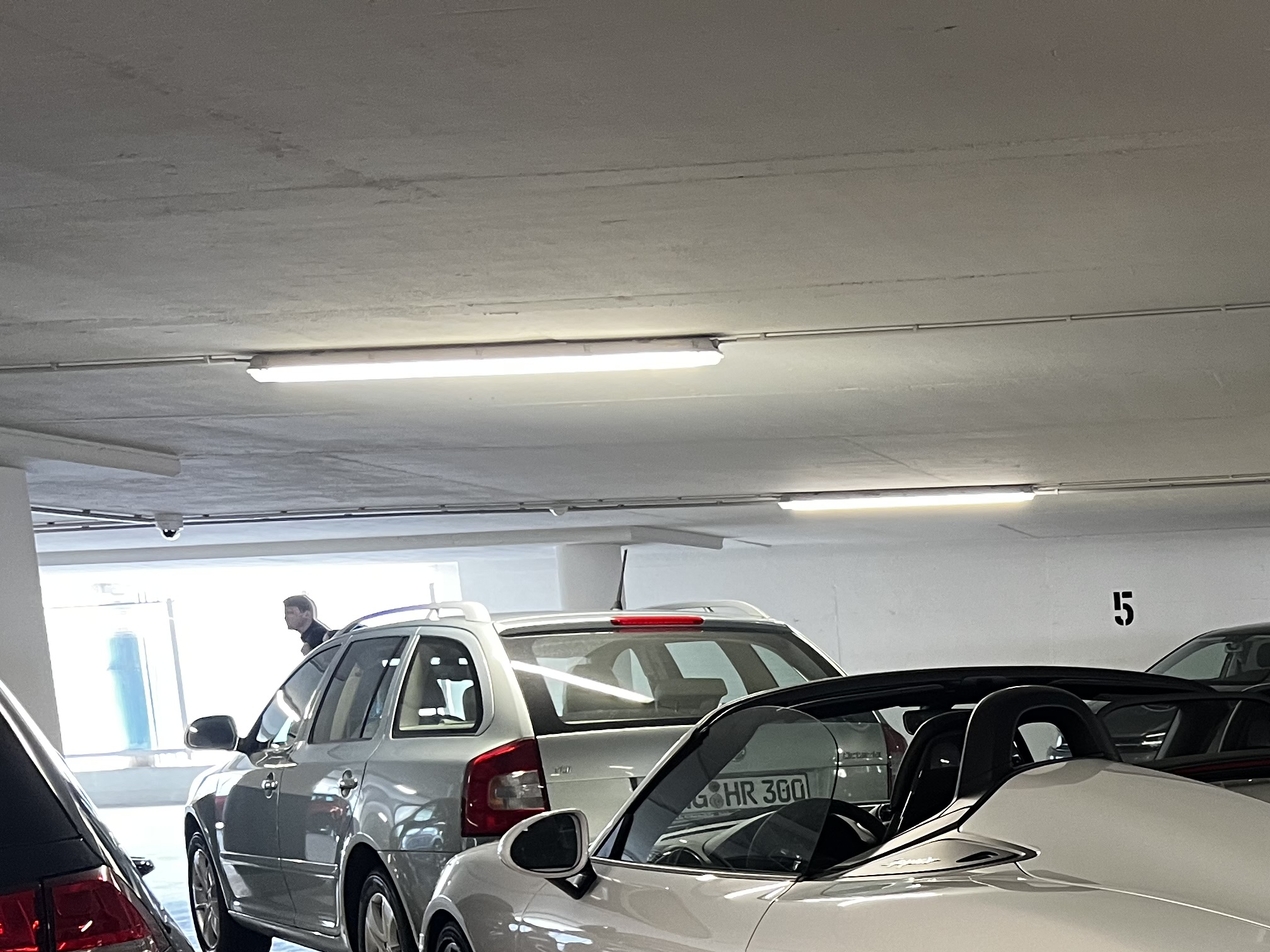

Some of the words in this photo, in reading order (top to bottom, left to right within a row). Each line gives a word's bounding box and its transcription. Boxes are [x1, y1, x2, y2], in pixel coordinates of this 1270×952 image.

[1113, 591, 1134, 626] 5
[723, 780, 759, 807] HR
[762, 778, 806, 804] 300
